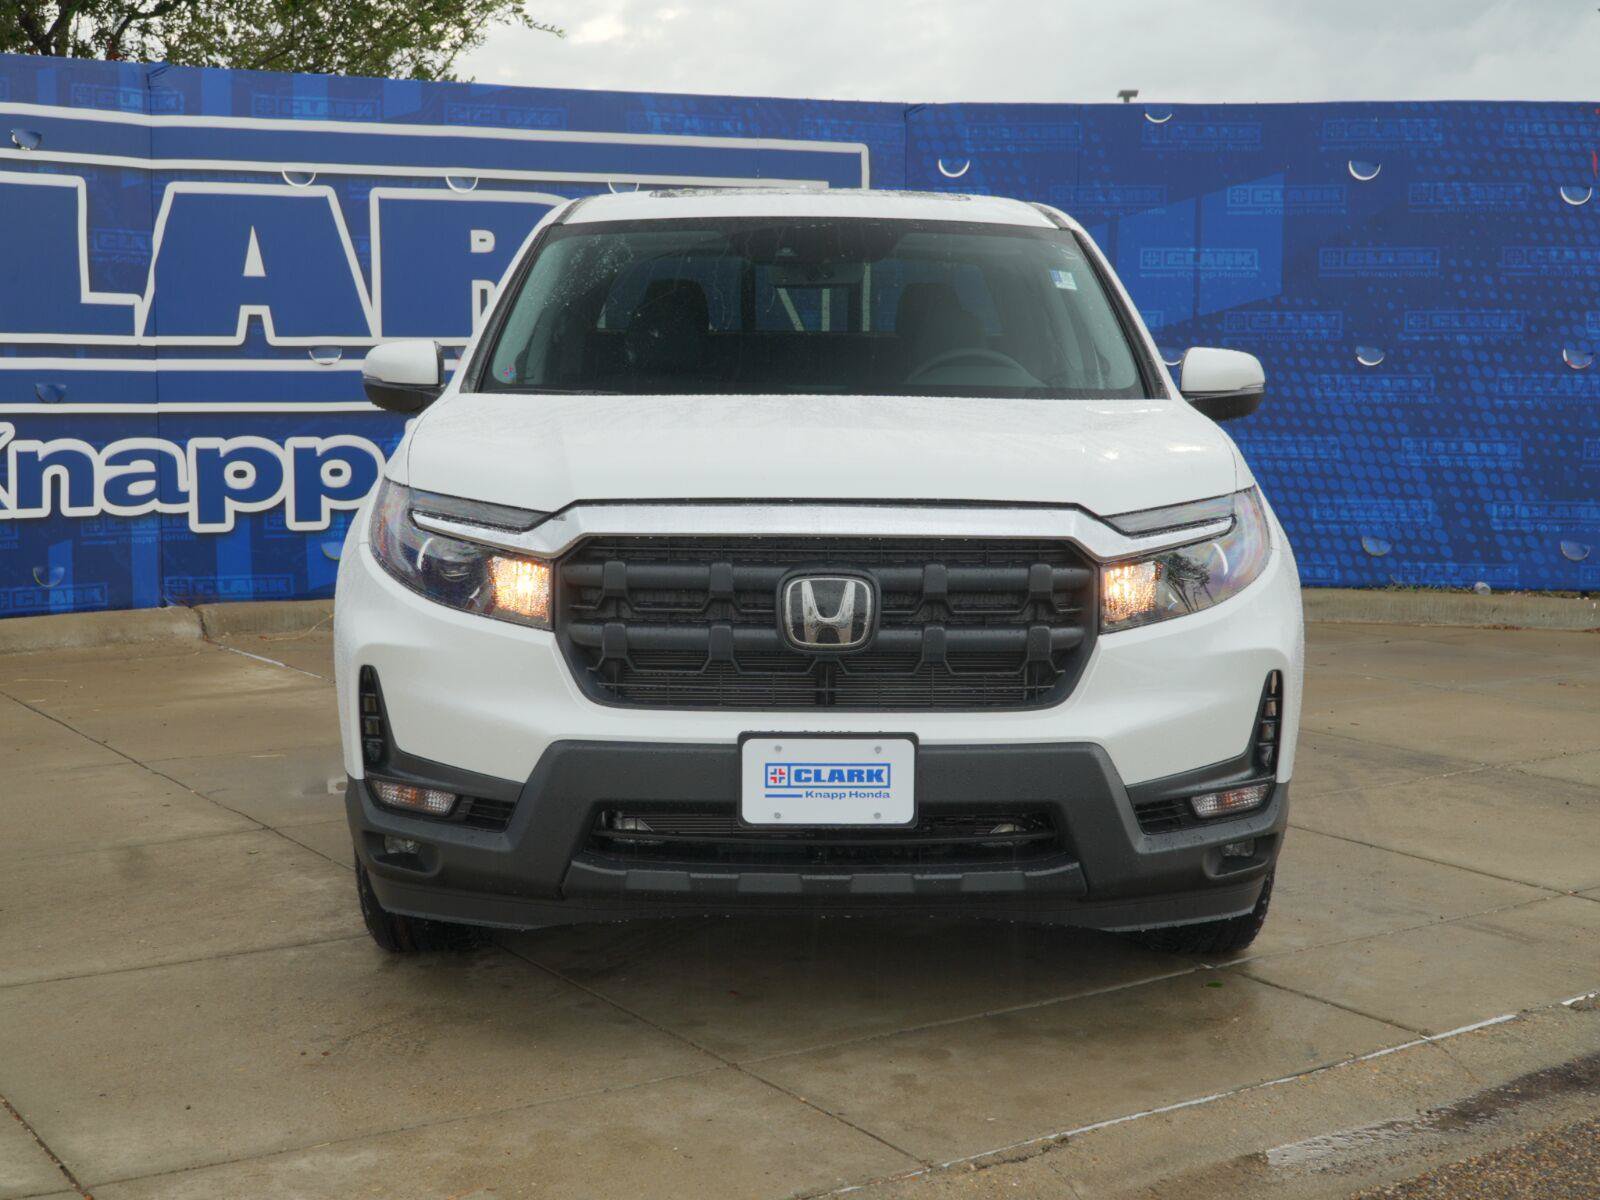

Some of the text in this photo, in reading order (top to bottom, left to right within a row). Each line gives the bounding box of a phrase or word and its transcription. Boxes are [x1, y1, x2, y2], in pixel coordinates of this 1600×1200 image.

[1167, 252, 1253, 265] CLARK
[0, 421, 386, 533] napp
[794, 768, 885, 783] CLARK
[805, 790, 891, 800] Knapp Honda
